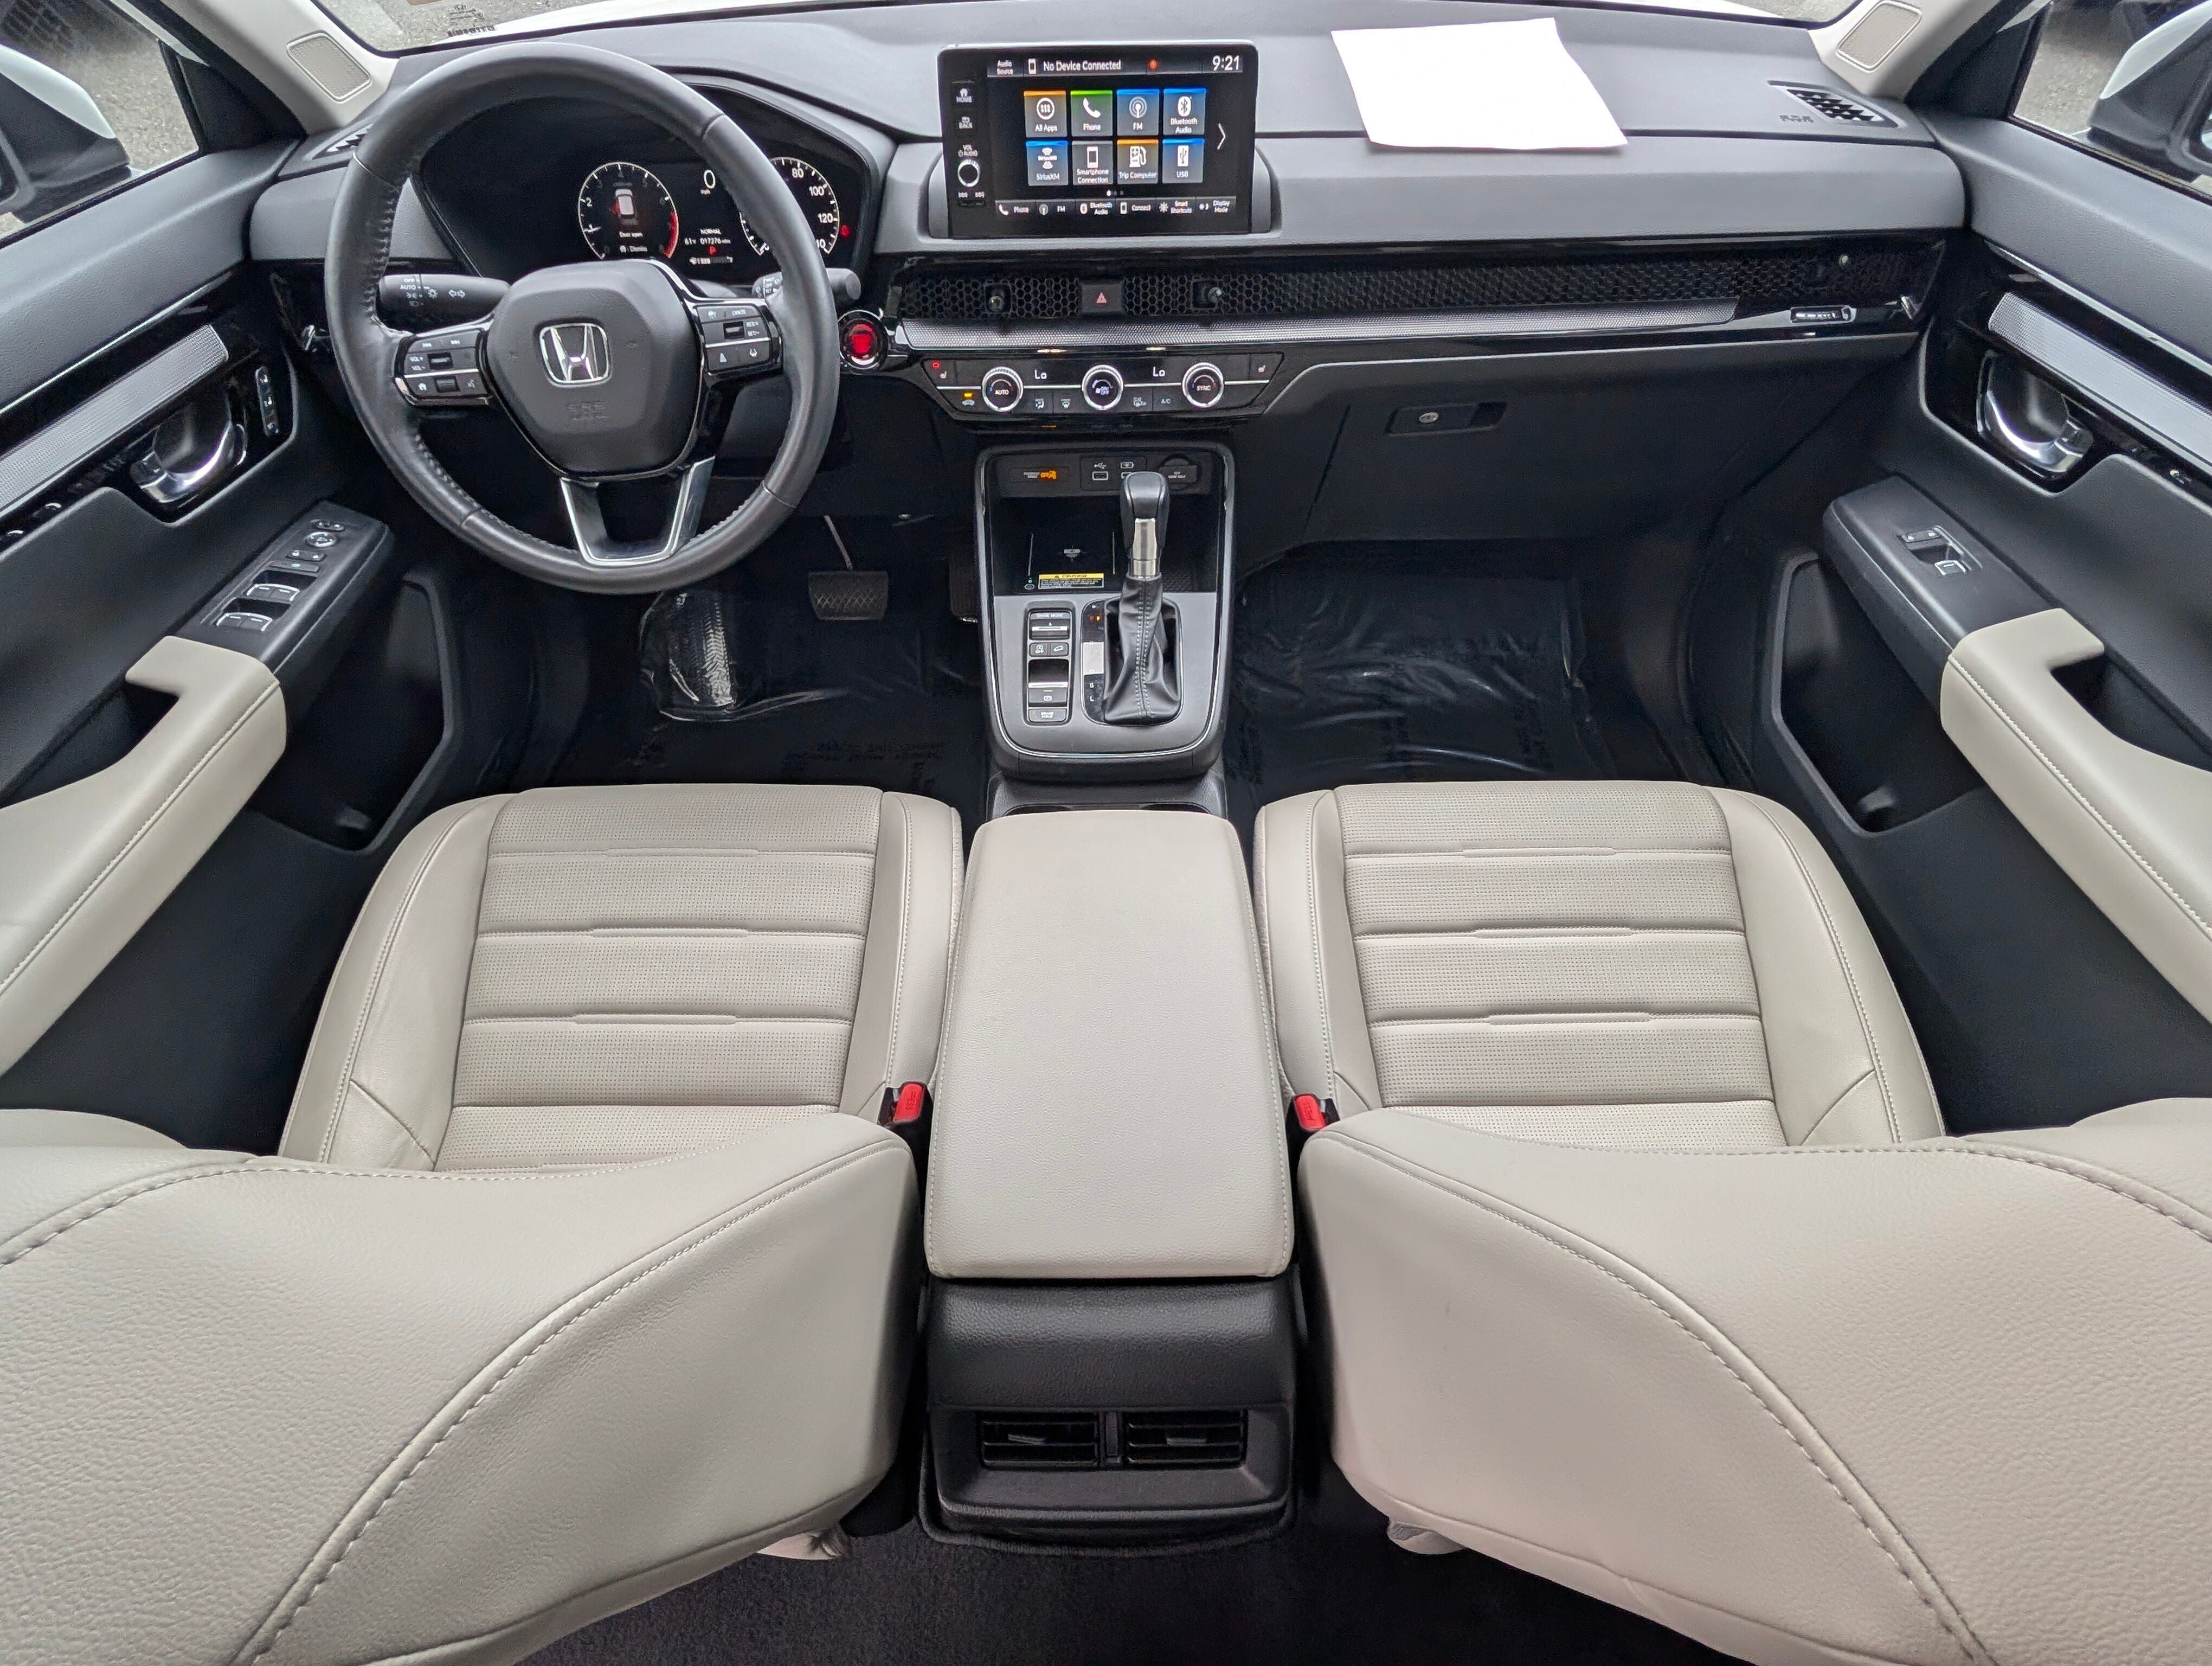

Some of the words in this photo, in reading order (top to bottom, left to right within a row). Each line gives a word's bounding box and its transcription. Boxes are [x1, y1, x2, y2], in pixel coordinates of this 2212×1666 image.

[1043, 61, 1054, 72] No
[1056, 60, 1081, 71] Device
[1082, 59, 1121, 71] Connected
[1212, 55, 1240, 71] 9:21
[1171, 117, 1198, 125] Bluetooth
[1044, 124, 1058, 133] Apps
[1083, 123, 1101, 131] Phone
[792, 167, 805, 178] 80
[1119, 171, 1129, 180] Trip
[1129, 171, 1157, 180] Computer
[704, 169, 716, 189] 0
[809, 185, 825, 196] 100
[586, 196, 593, 207] 2
[818, 213, 833, 223] 120
[1034, 369, 1047, 380] Lo
[1152, 366, 1166, 377] Lo
